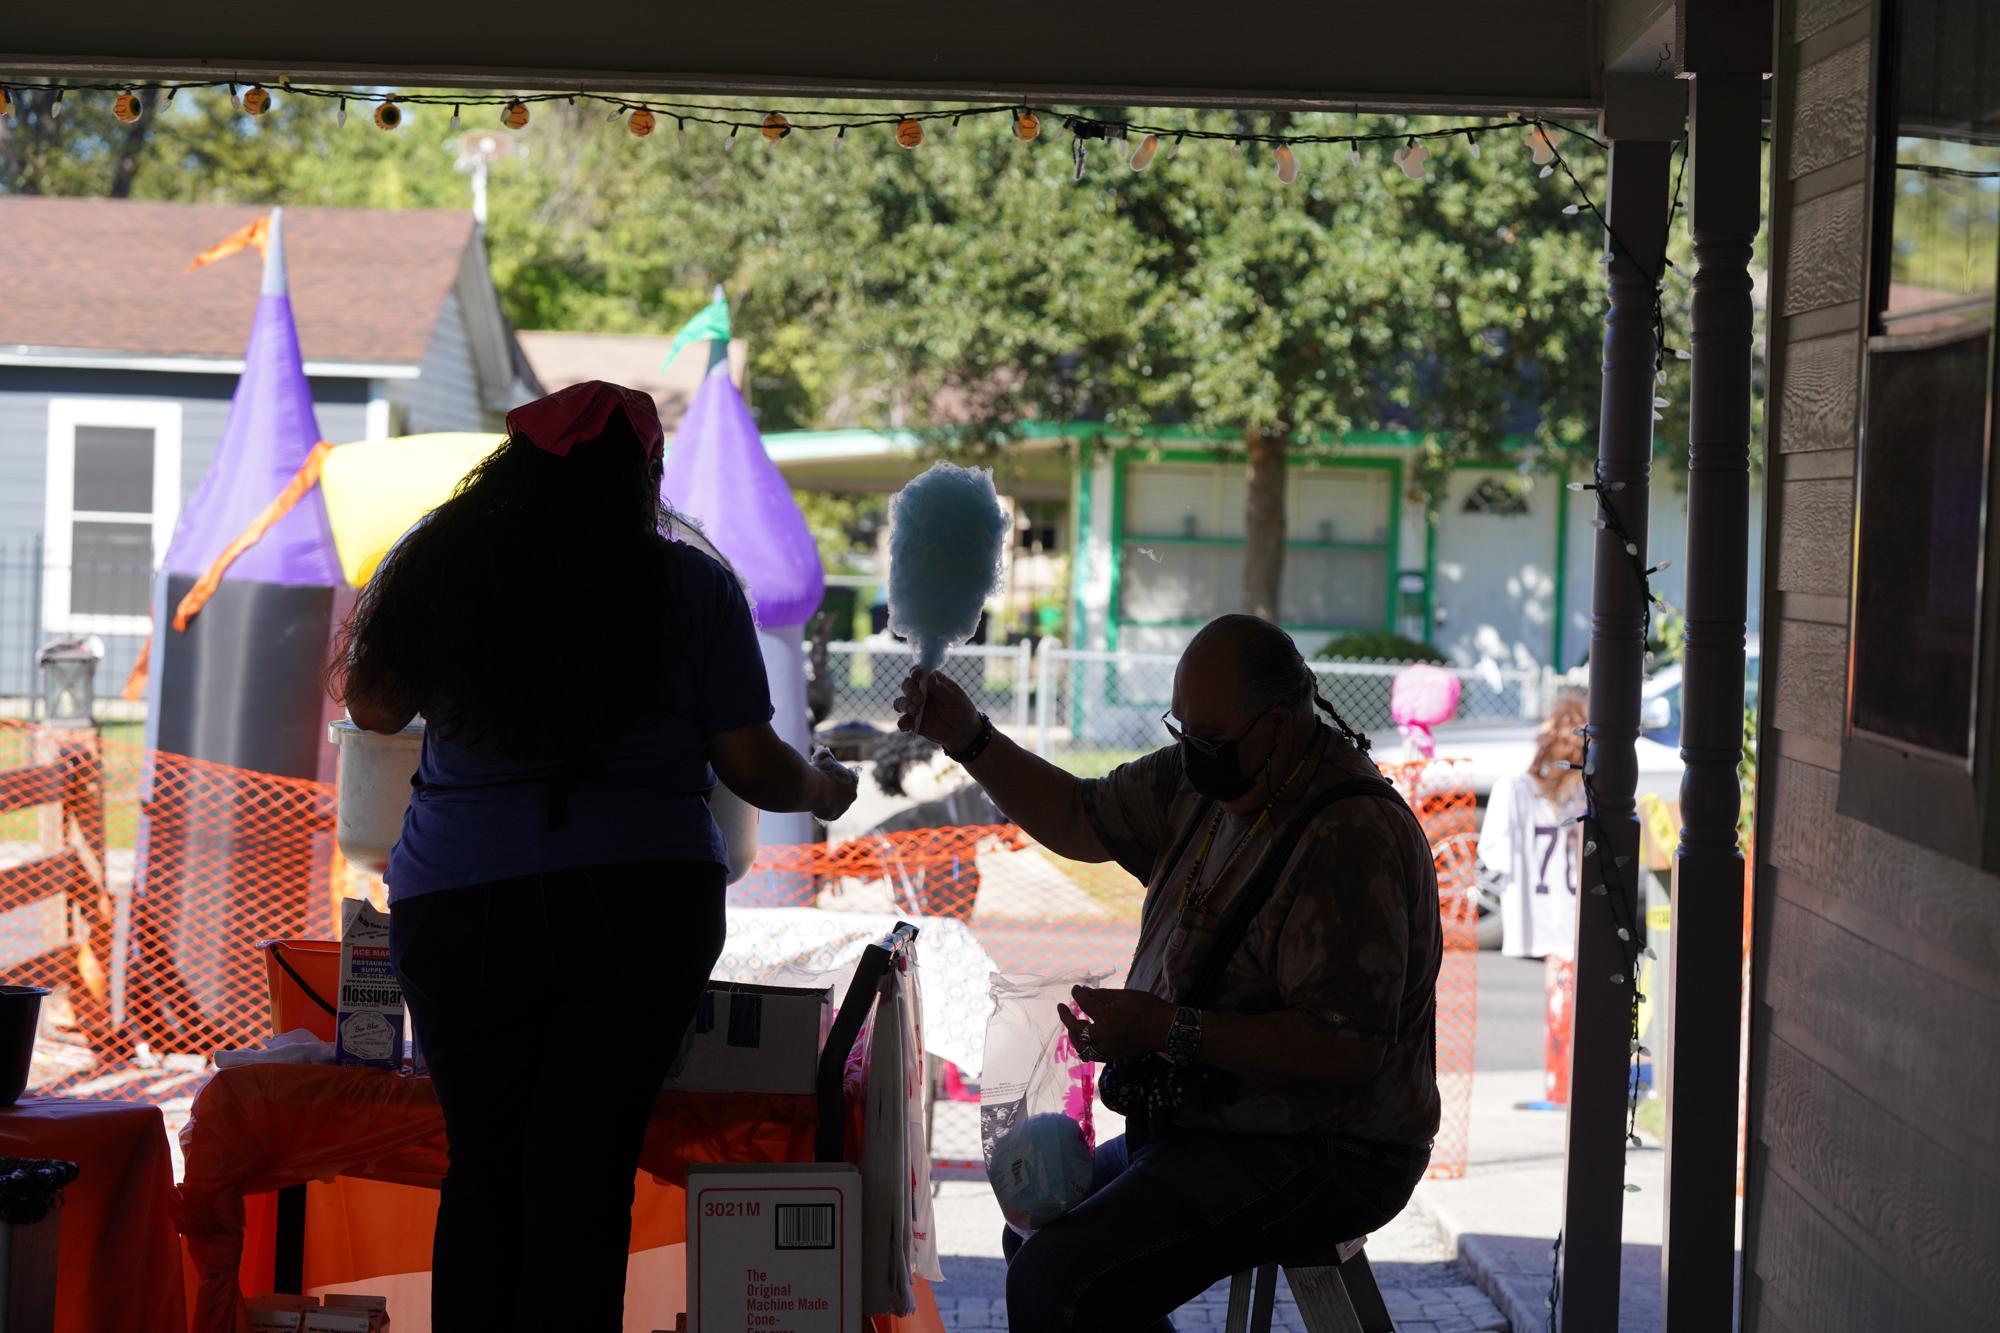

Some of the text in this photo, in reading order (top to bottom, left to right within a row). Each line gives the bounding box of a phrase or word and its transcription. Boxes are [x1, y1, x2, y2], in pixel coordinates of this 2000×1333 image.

[353, 949, 370, 957] ACE
[343, 984, 403, 1005] flossugar
[705, 1202, 760, 1216] 3021M
[746, 1269, 767, 1282] The
[747, 1284, 791, 1298] Original
[746, 1298, 828, 1312] Machine Made
[747, 1313, 781, 1326] Cone-
